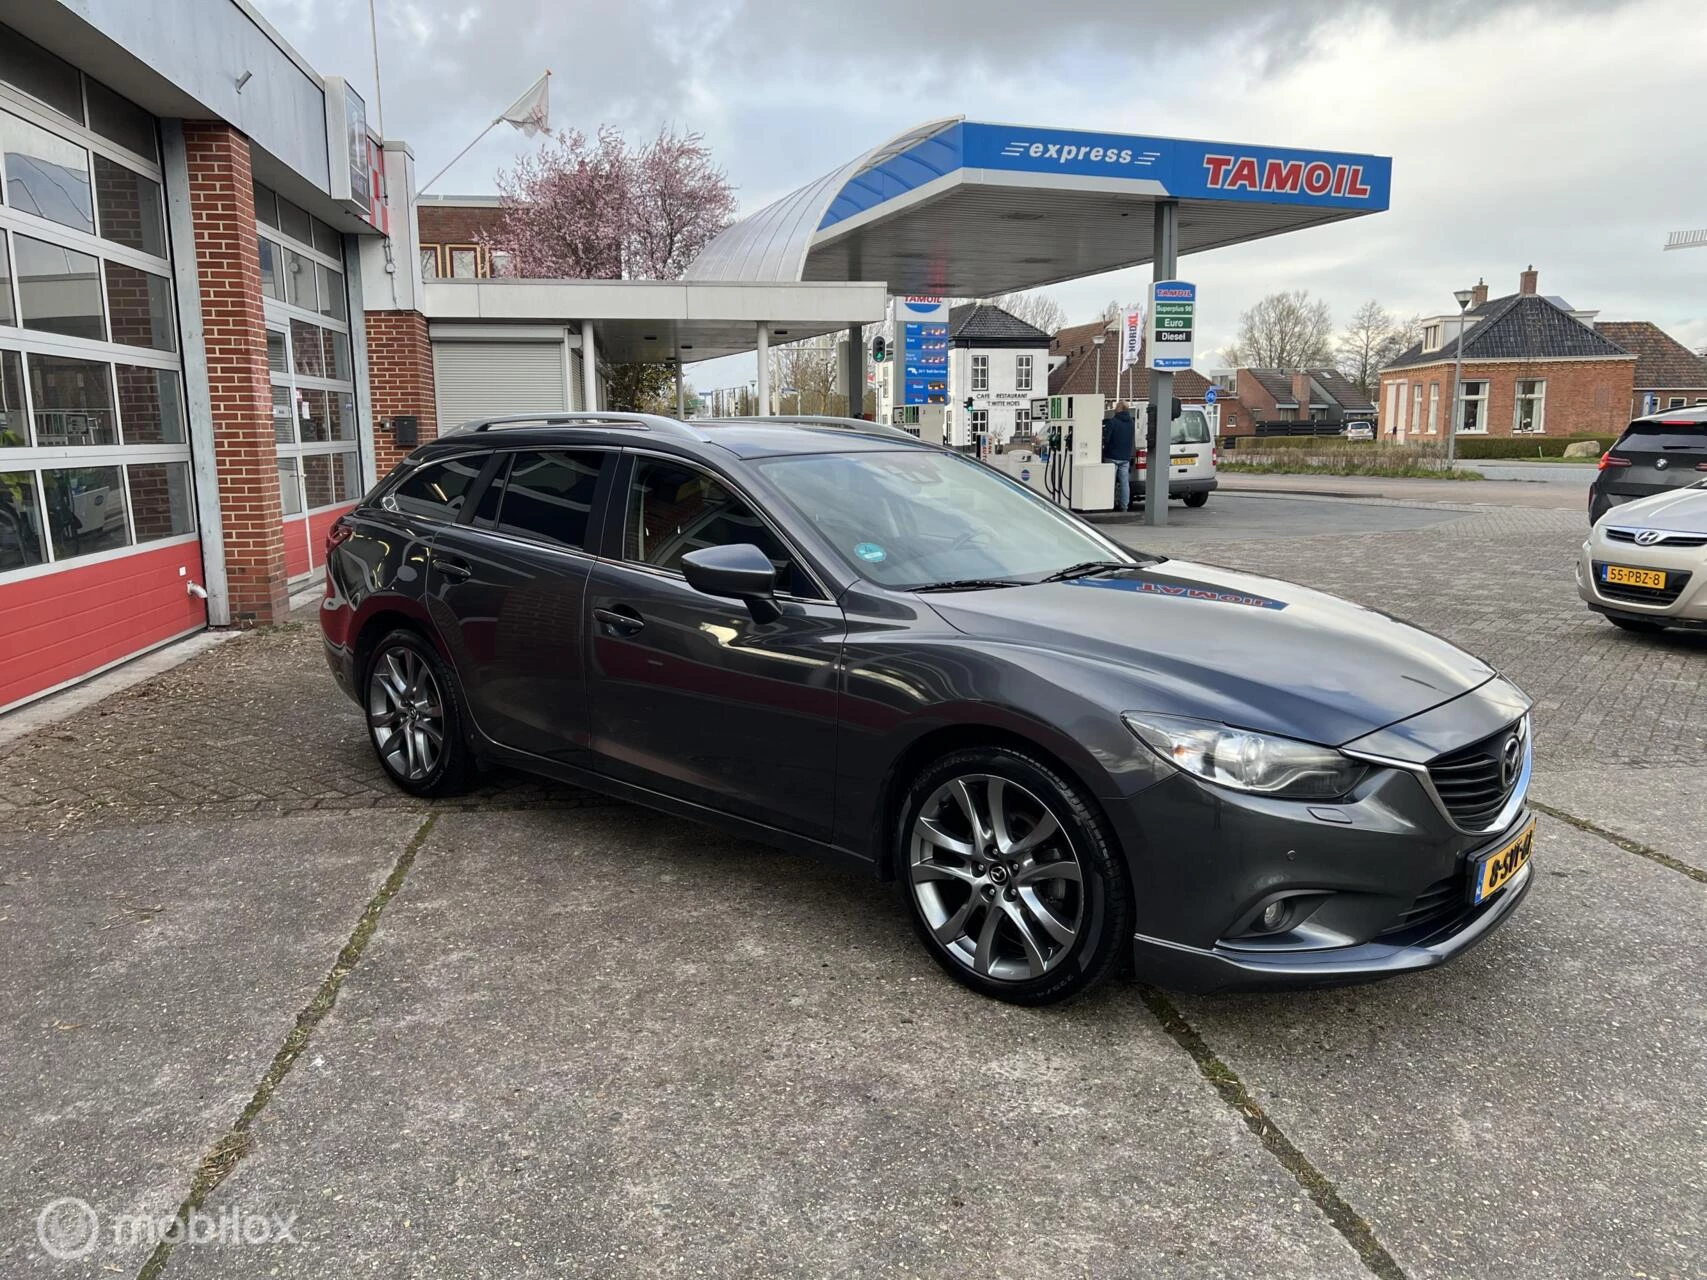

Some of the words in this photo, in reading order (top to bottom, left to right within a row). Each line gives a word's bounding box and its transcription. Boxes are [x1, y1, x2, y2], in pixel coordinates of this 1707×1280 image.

[1028, 140, 1133, 165] express
[1203, 153, 1372, 198] TAMOIL
[1156, 289, 1193, 298] TAMOIL
[1164, 318, 1184, 327] Euro
[1161, 332, 1186, 341] Diesel
[1610, 568, 1661, 586] 55-PBZ-8
